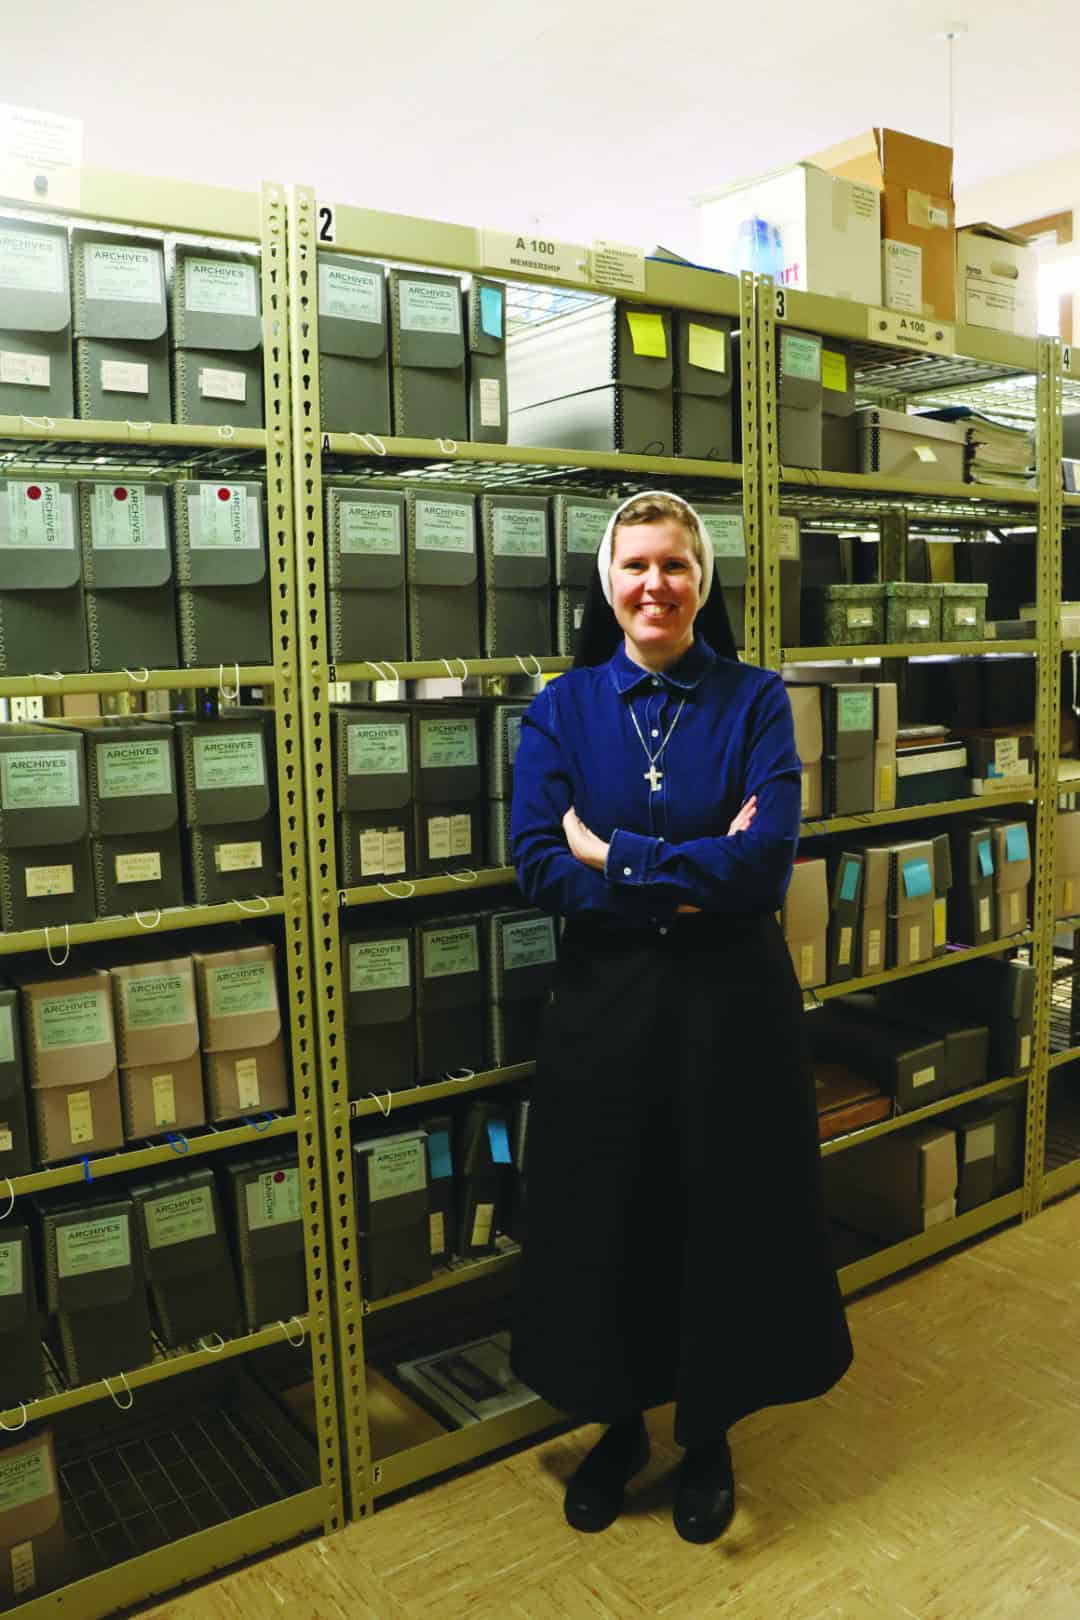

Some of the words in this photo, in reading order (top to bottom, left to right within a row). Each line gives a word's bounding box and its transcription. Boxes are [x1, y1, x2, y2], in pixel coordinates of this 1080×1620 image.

[319, 207, 333, 241] 2
[515, 237, 526, 250] A
[530, 239, 555, 255] 100
[94, 251, 149, 264] ARCHIVES
[193, 265, 245, 279] ARCHIVES
[510, 258, 561, 272] MEMBERSHIP
[328, 271, 374, 286] ARCHIVES
[408, 286, 453, 298] ARCHIVES
[776, 290, 785, 318] 3
[900, 318, 907, 328] A
[910, 320, 925, 333] 100
[1063, 347, 1070, 369] 4
[323, 434, 330, 452] A
[43, 486, 55, 542] ARCHIVES
[128, 488, 138, 543] ARCHIVES
[232, 490, 241, 543] ARCHIVES
[349, 507, 393, 518] ARCHIVES
[423, 506, 465, 518] ARCHIVES
[501, 514, 539, 523] ARCHIVES
[357, 728, 400, 738] ARCHIVES
[427, 724, 469, 733] ARCHIVES
[106, 746, 159, 760] ARCHIVES
[202, 741, 253, 753] ARCHIVES
[10, 759, 67, 769] ARCHIVES
[430, 932, 471, 945] ARCHIVES
[358, 945, 401, 955] ARCHIVES
[216, 967, 265, 983] ARCHIVES
[130, 980, 181, 993] ARCHIVES
[43, 999, 97, 1015] ARCHIVES
[377, 1148, 417, 1162] ARCHIVES
[265, 1175, 273, 1219] ARCHIVES
[155, 1197, 203, 1216] ARCHIVES
[68, 1223, 121, 1241] ARCHIVES
[374, 1465, 381, 1482] F
